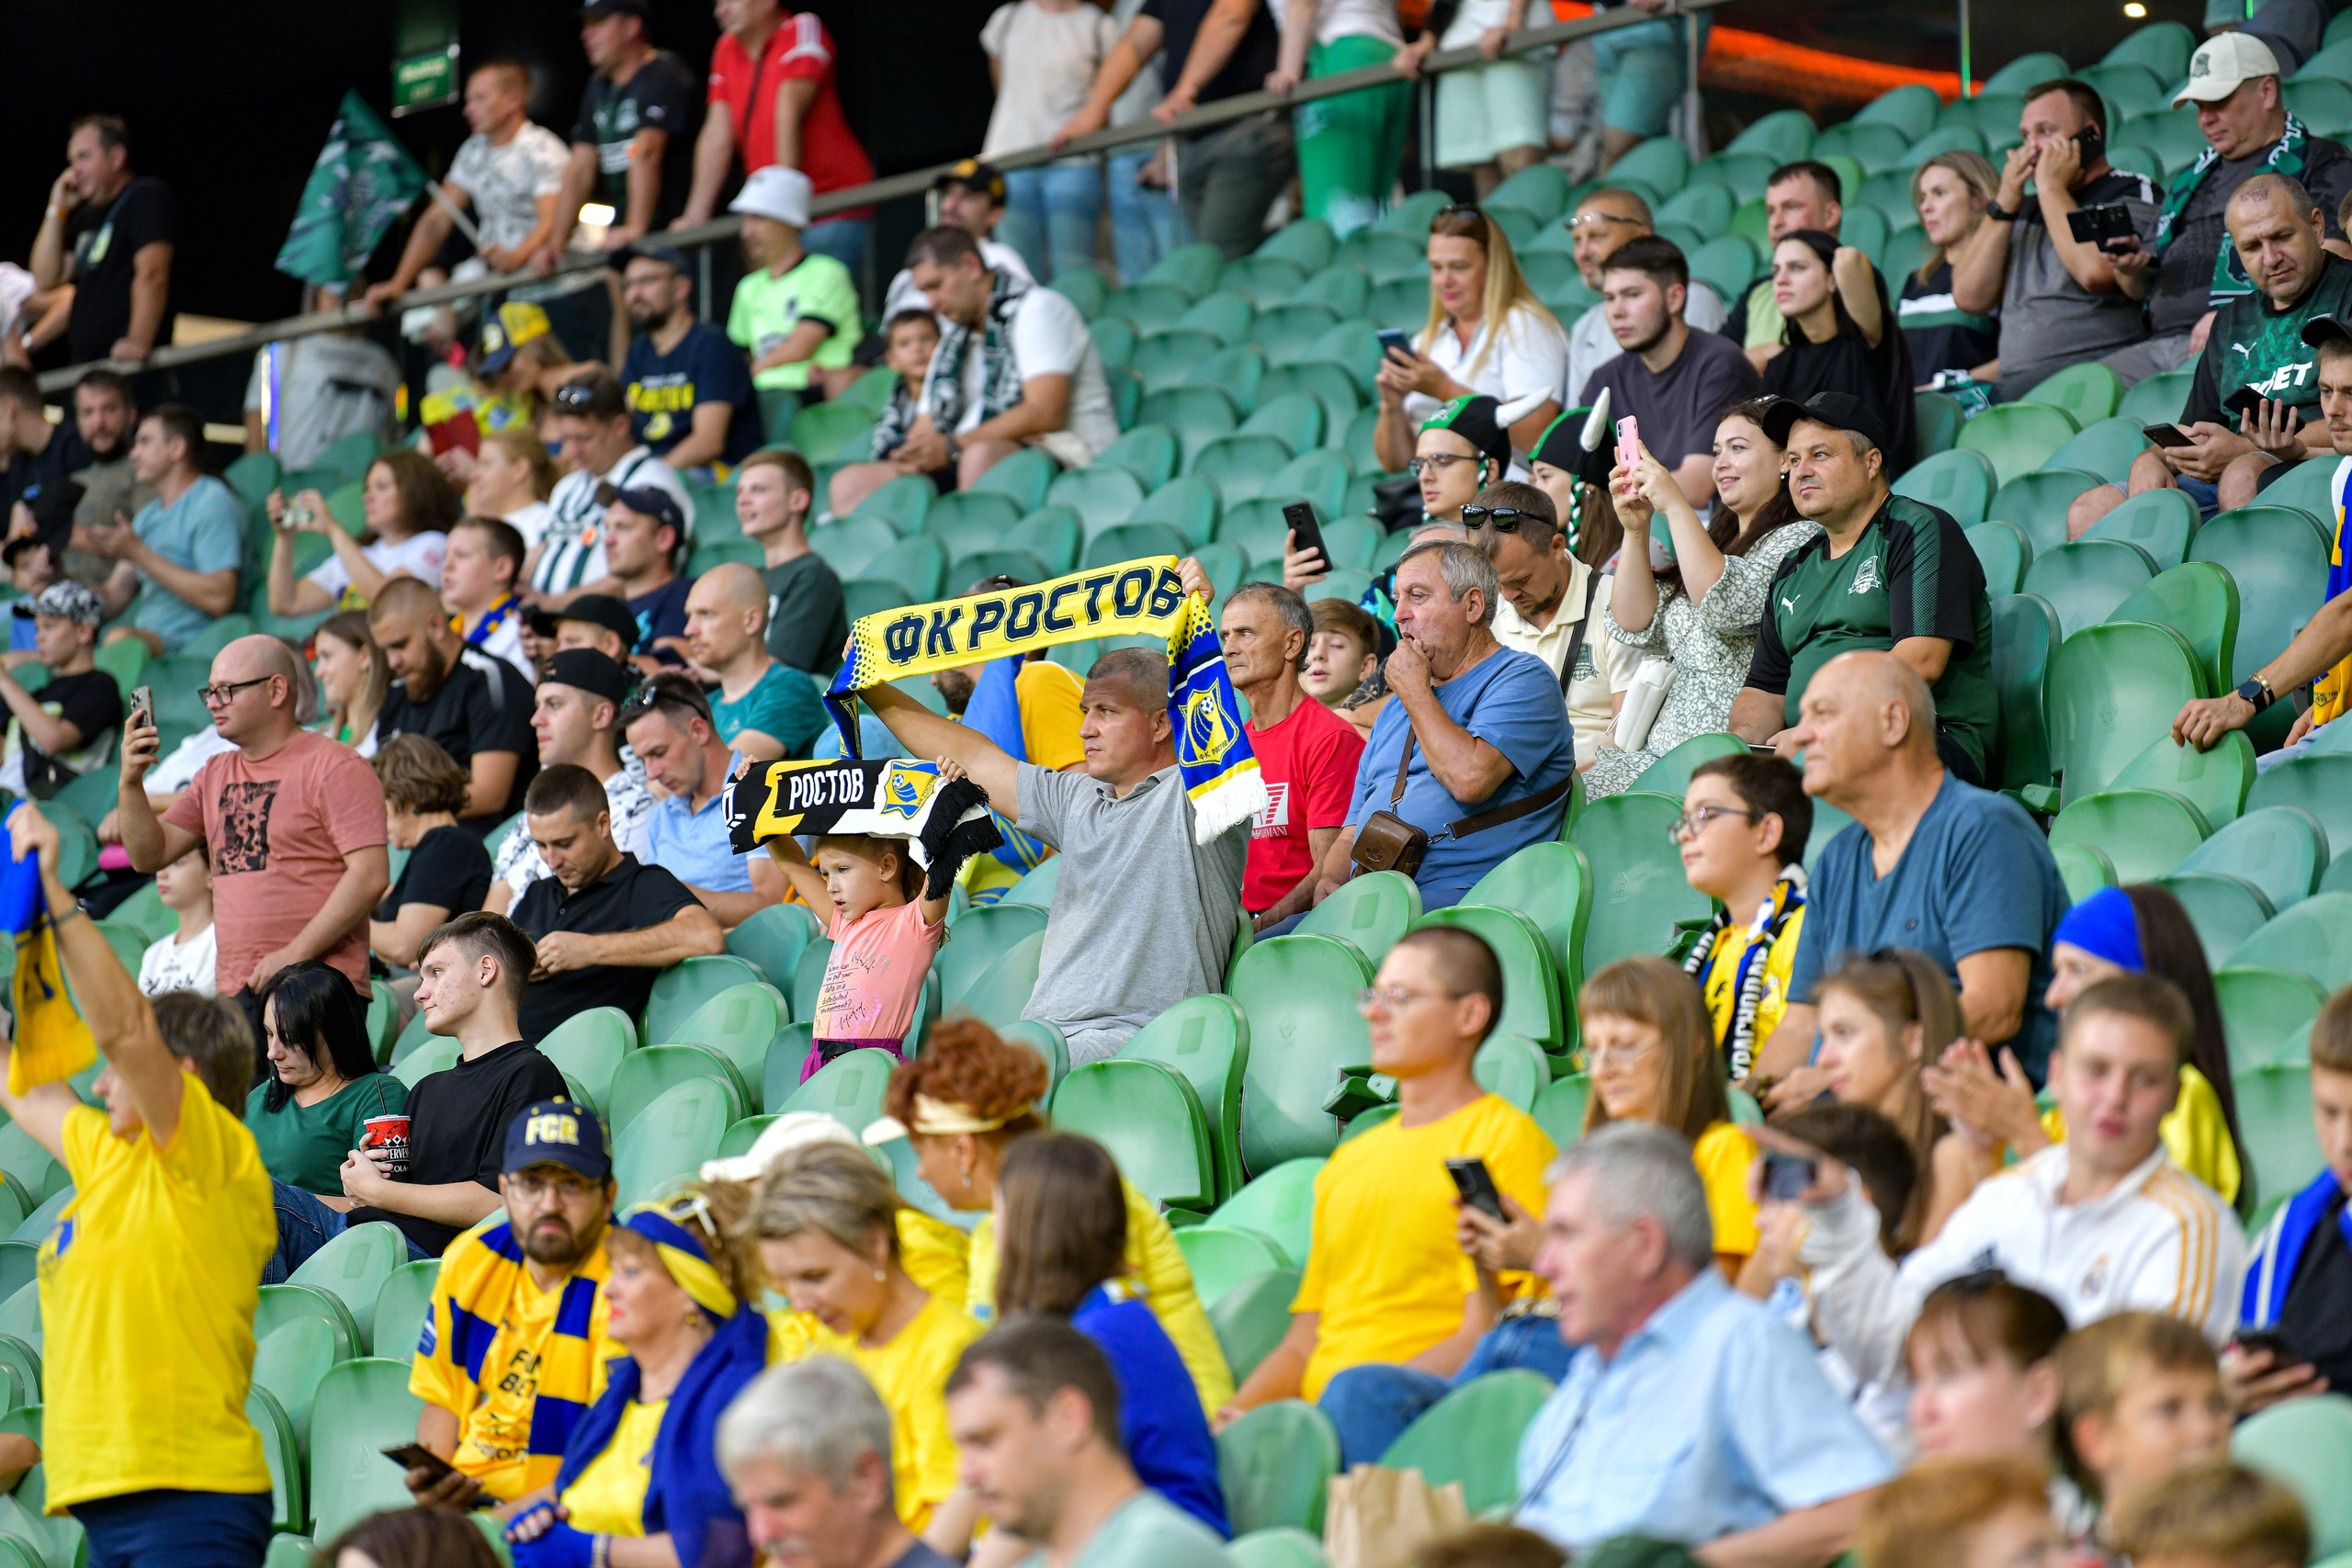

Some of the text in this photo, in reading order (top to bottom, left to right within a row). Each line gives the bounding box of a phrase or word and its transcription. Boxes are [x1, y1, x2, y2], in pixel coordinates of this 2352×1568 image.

[884, 566, 1182, 667] ФК РОСТОВ
[788, 768, 864, 810] РОСТОВ
[525, 1113, 580, 1145] FCR
